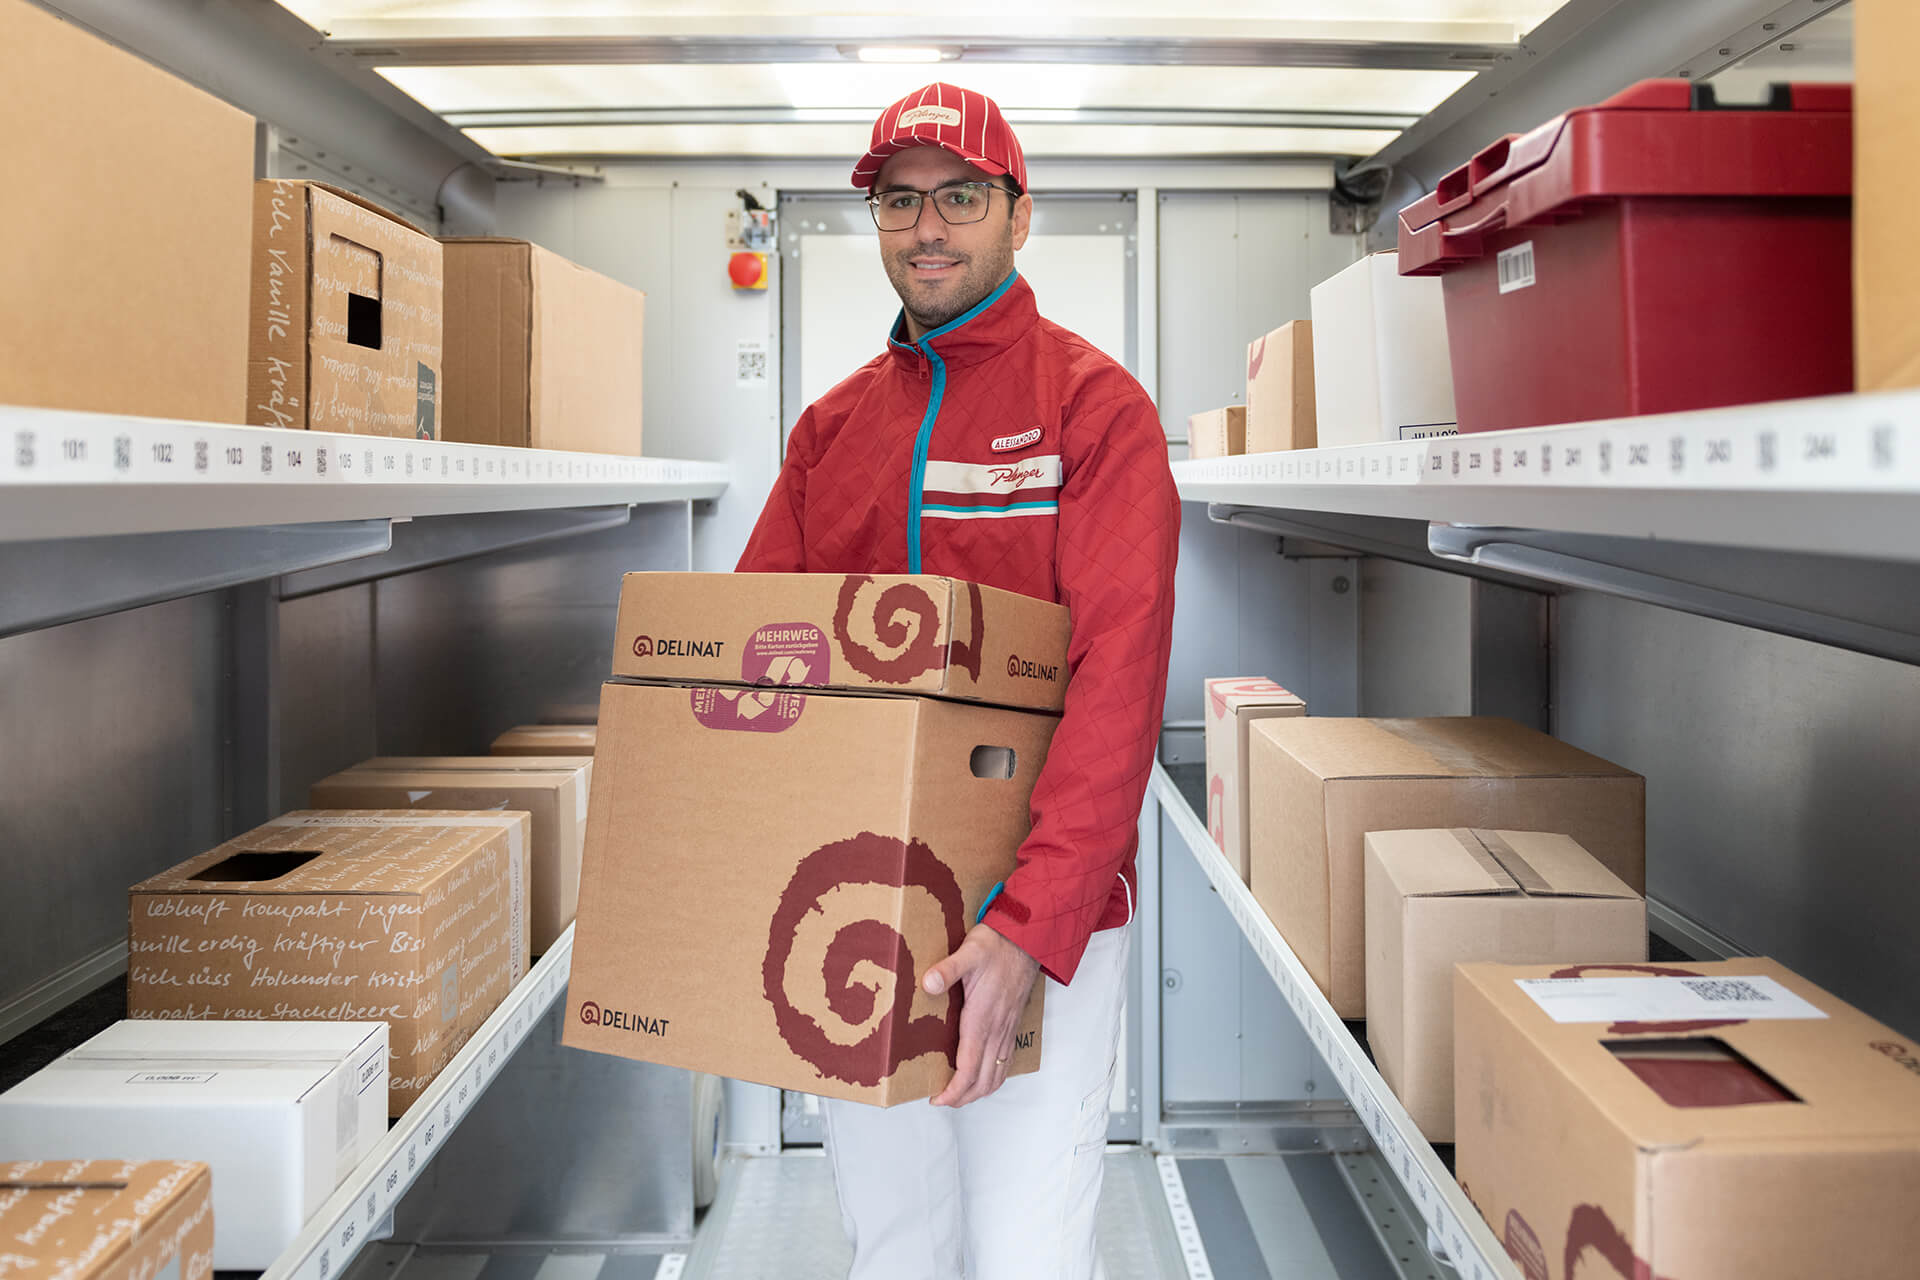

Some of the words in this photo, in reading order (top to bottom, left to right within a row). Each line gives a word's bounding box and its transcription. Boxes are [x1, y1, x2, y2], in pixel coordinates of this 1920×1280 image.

[268, 249, 293, 341] Vanille
[995, 430, 1039, 449] ALESSANDRO
[62, 439, 87, 461] 101
[152, 443, 174, 463] 102
[226, 447, 242, 465] 103
[287, 450, 301, 467] 104
[339, 453, 352, 470] 105
[756, 629, 818, 642] MEHRWEG
[657, 639, 724, 658] DELINAT
[1021, 660, 1058, 682] DELINAT
[250, 966, 358, 987] Holunder
[603, 1009, 669, 1037] DELINAT
[424, 1123, 436, 1146] 067
